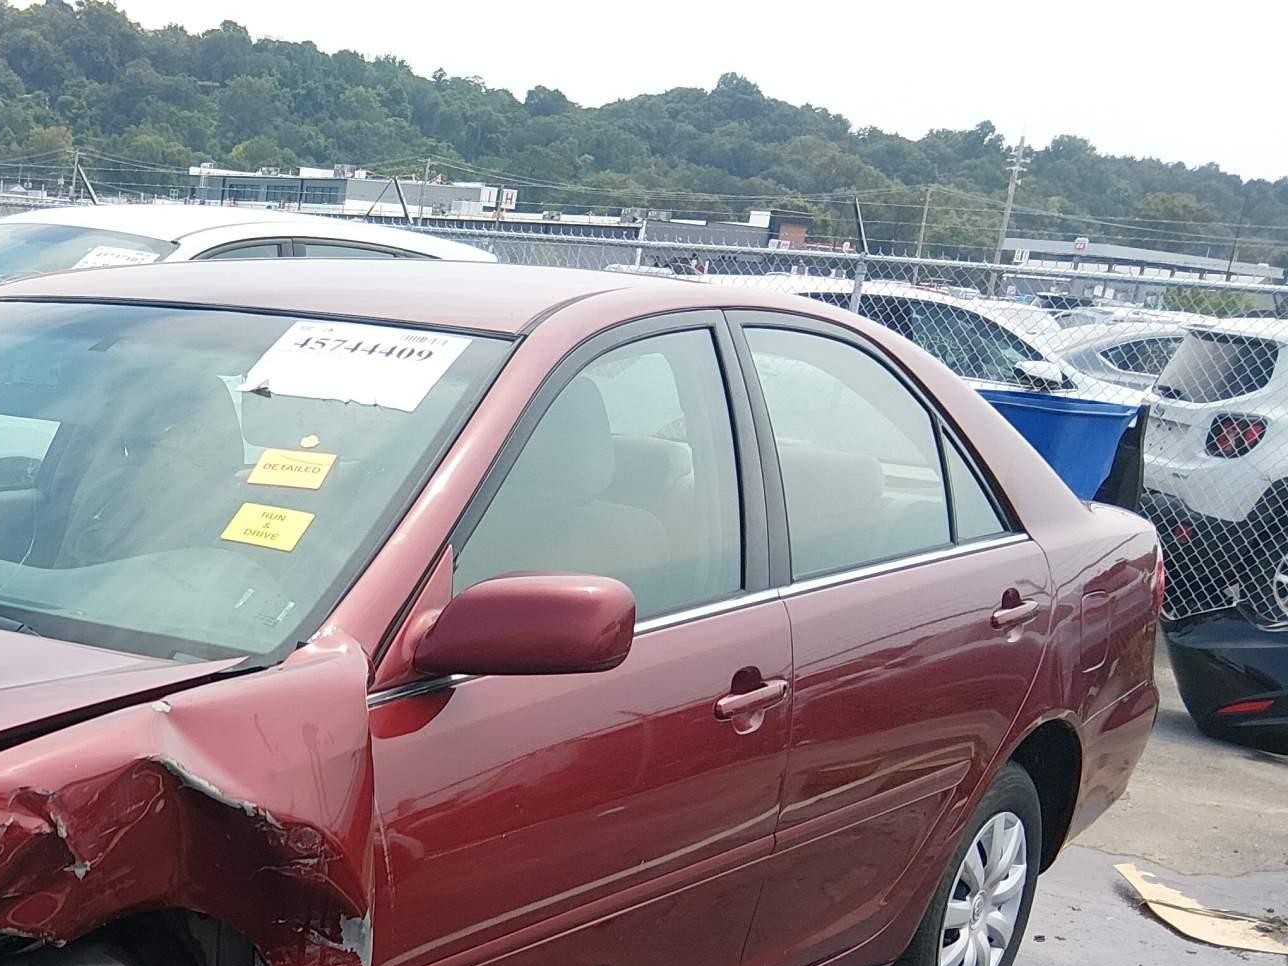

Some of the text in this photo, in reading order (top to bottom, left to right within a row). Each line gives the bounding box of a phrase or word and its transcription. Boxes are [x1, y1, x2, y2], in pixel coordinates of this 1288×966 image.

[294, 336, 434, 361] 45744409
[263, 463, 321, 474] DETAILED
[260, 511, 287, 522] RUN
[243, 528, 279, 541] DRIVE
